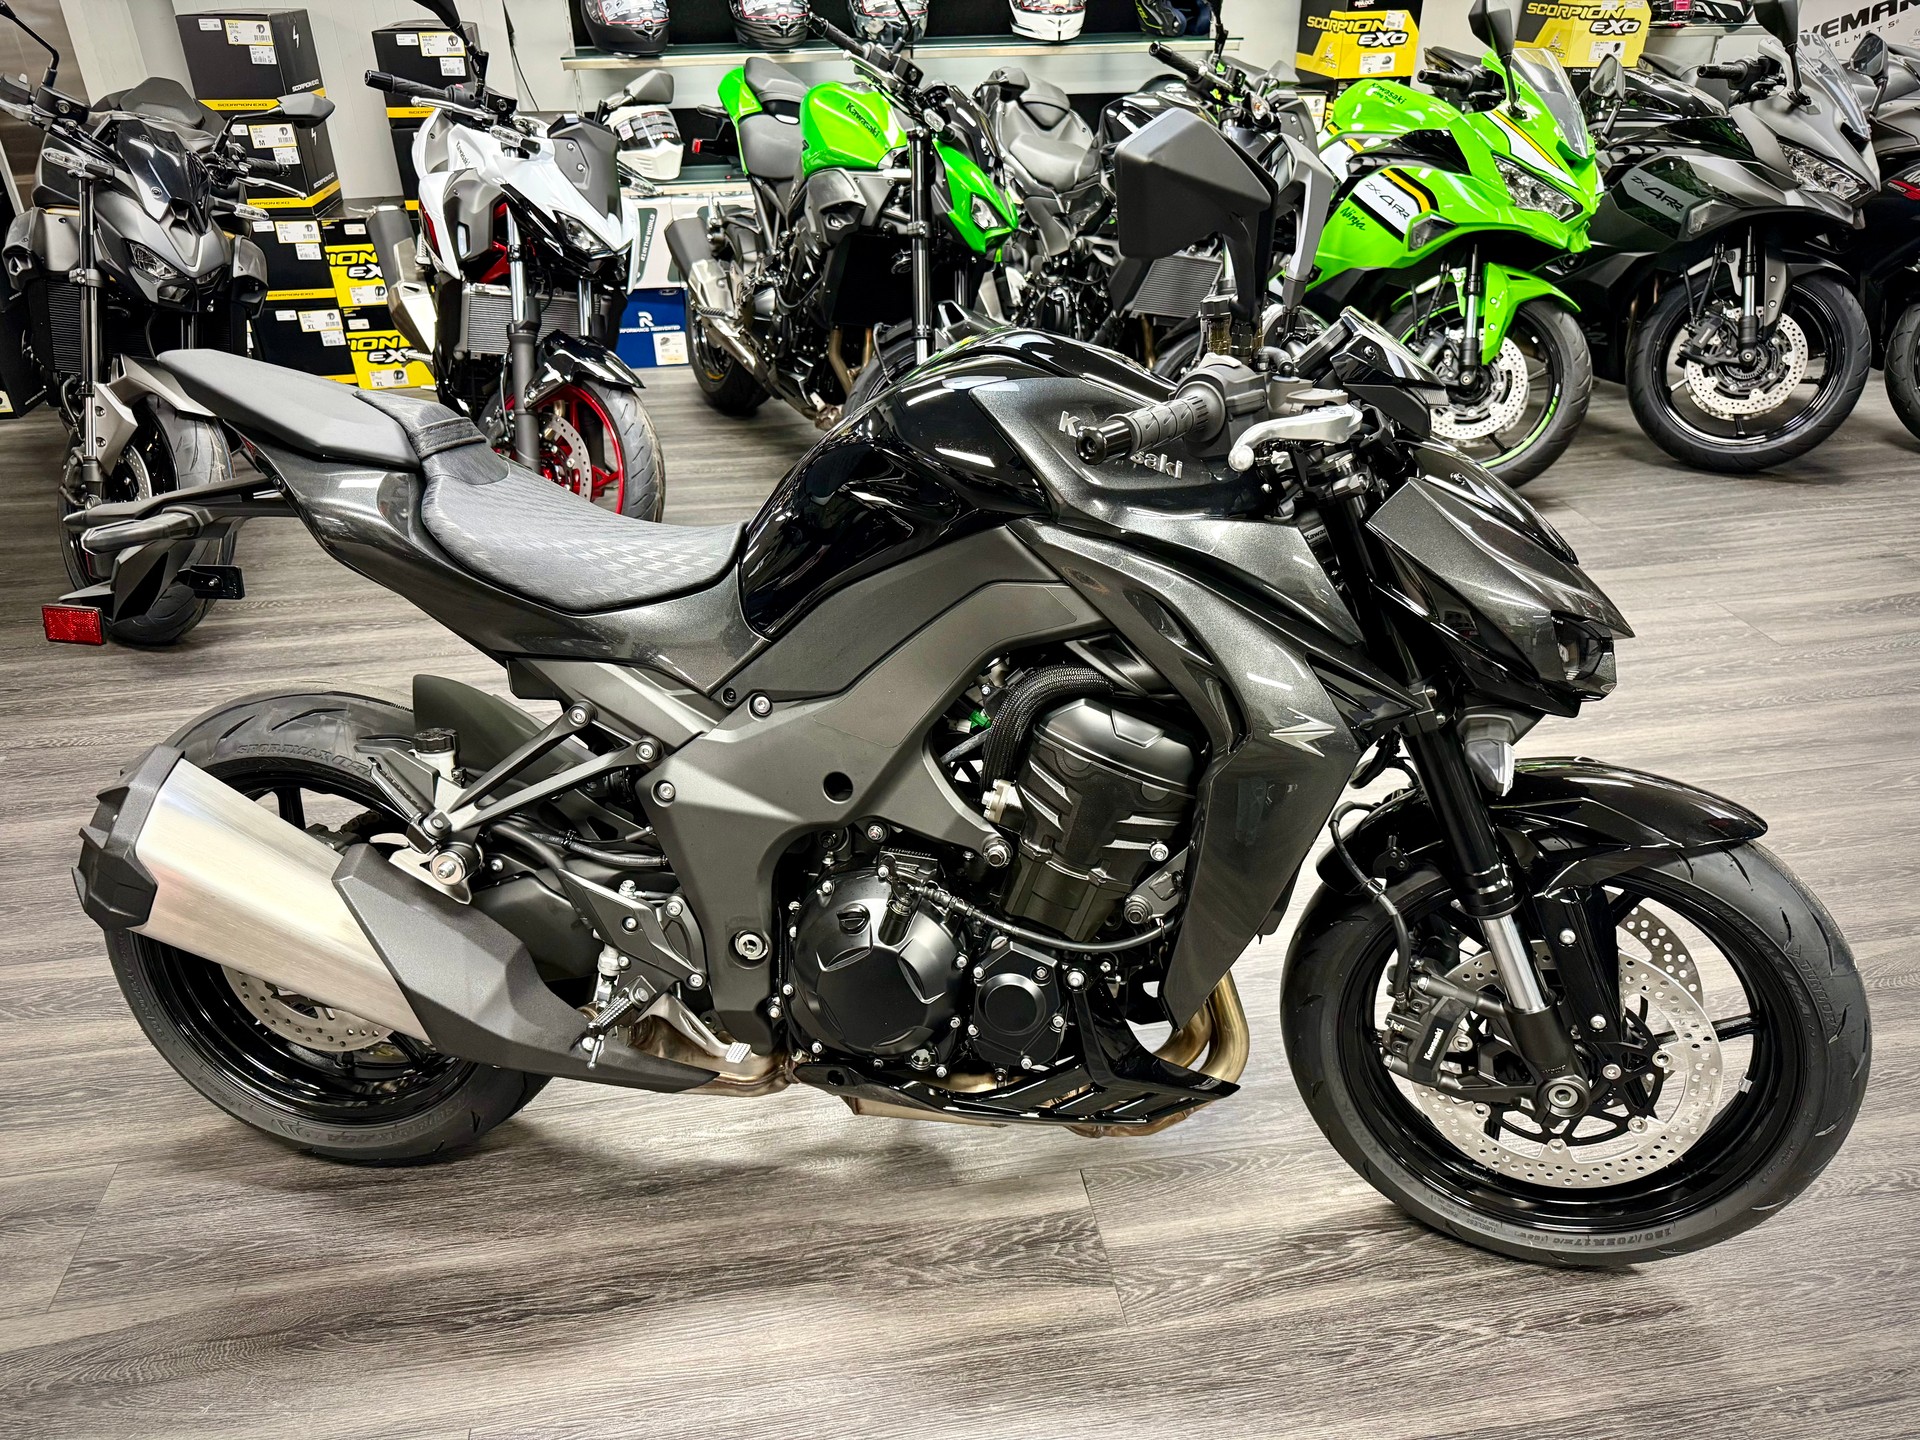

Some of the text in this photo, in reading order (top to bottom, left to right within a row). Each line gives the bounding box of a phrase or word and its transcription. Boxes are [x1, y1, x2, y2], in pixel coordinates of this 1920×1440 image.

[845, 102, 881, 138] Kawasaki
[456, 140, 471, 166] Kawasaki
[1364, 181, 1411, 220] ZX-4RR
[1631, 175, 1685, 213] ZX-4RR
[1340, 206, 1367, 231] Ninja
[348, 263, 384, 279] EX
[1423, 1027, 1444, 1061] Kawasaki
